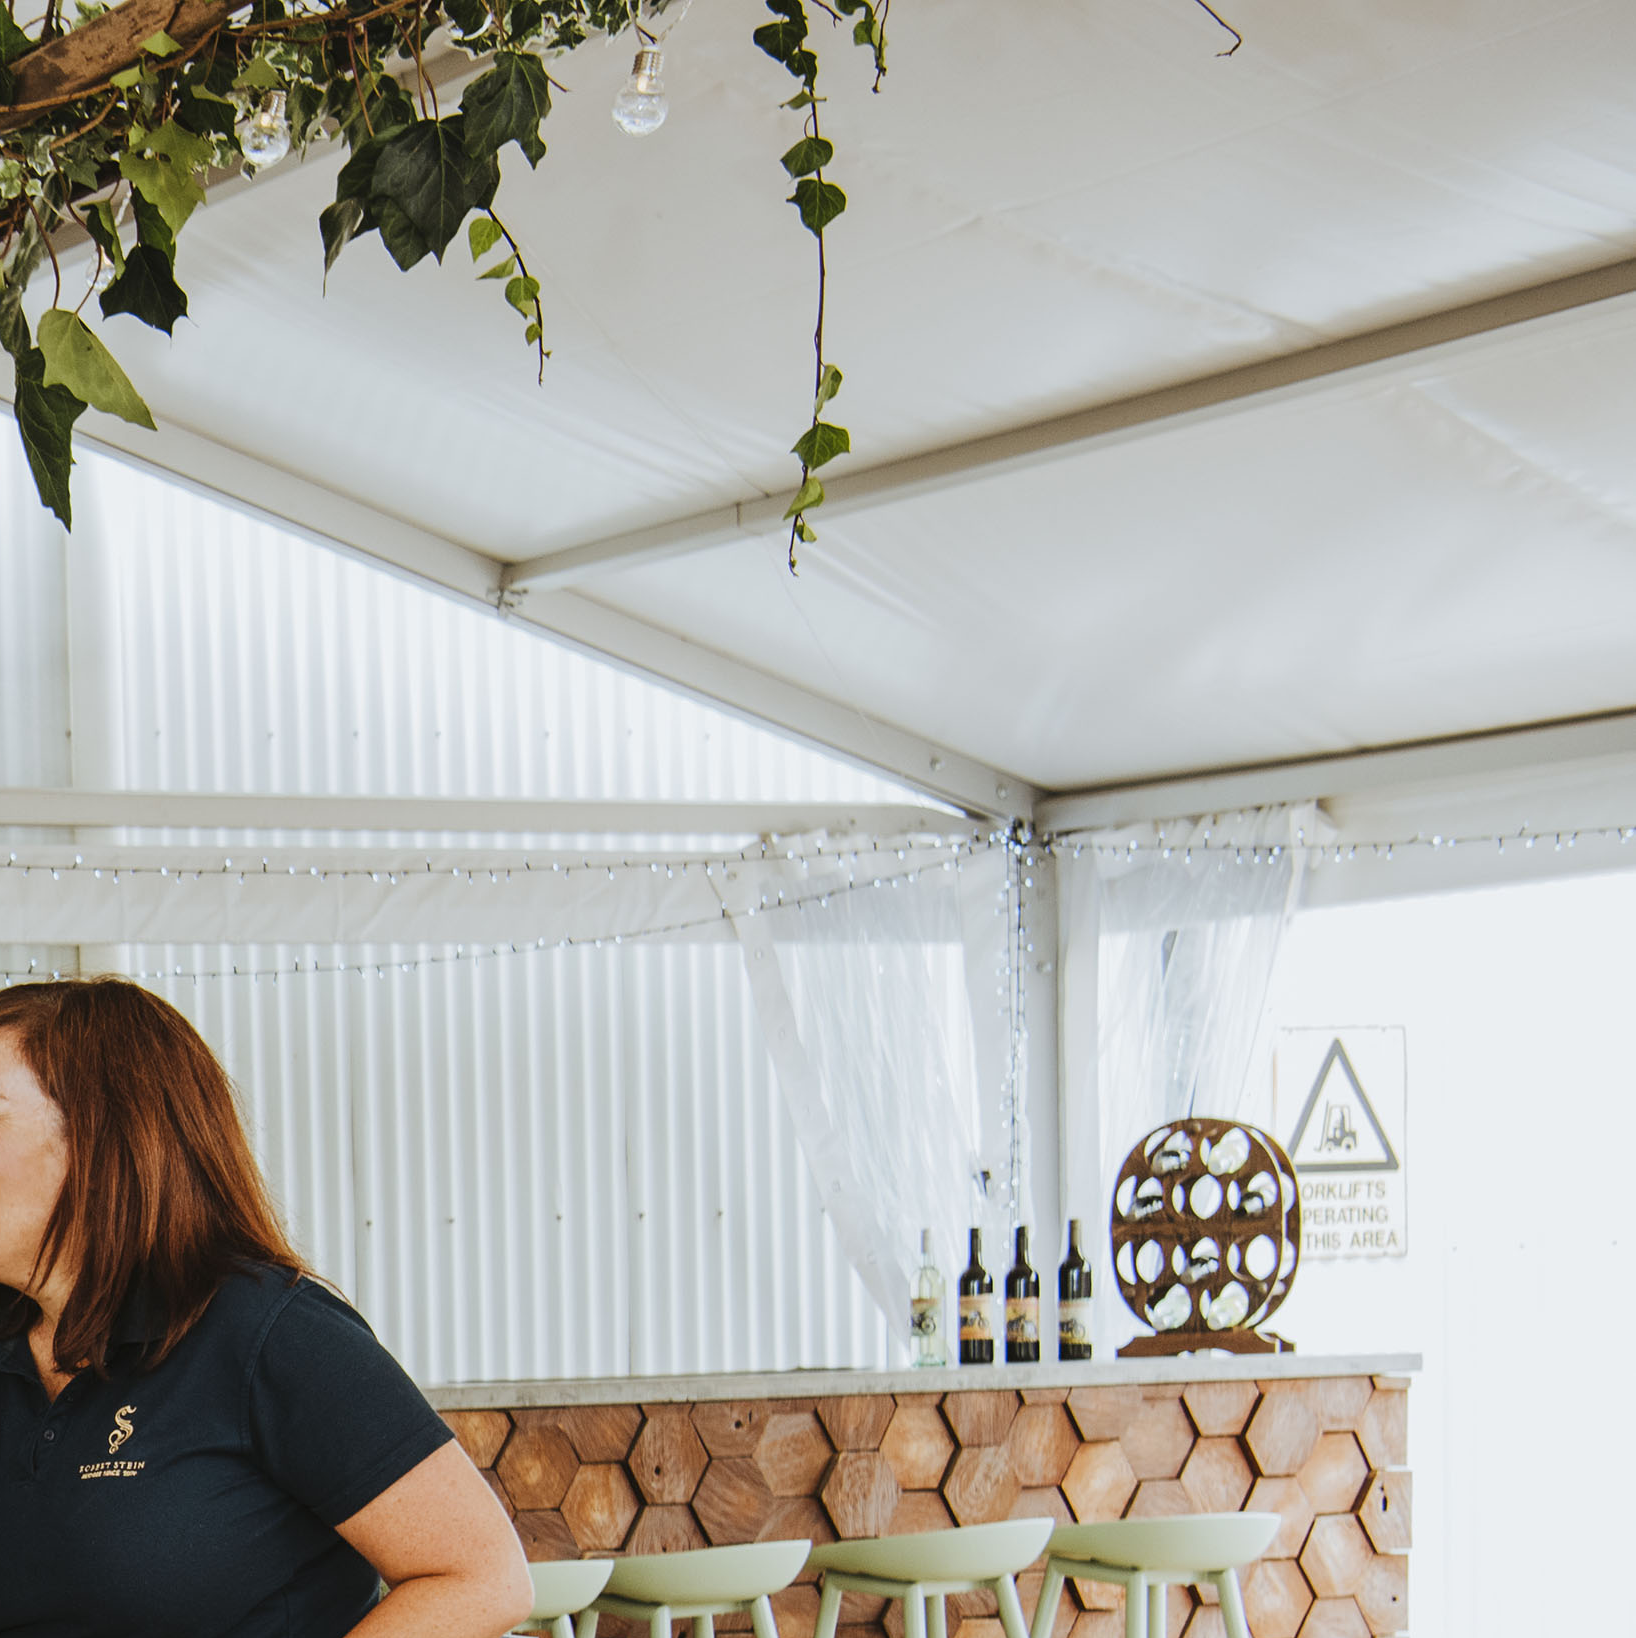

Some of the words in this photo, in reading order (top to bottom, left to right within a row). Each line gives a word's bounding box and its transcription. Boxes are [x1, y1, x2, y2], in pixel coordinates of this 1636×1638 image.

[1301, 1181, 1386, 1201] ORKLIFTS
[1302, 1207, 1389, 1225] PERATING
[1305, 1232, 1341, 1250] THIS
[1350, 1230, 1398, 1248] AREA
[113, 1460, 146, 1470] STEIN
